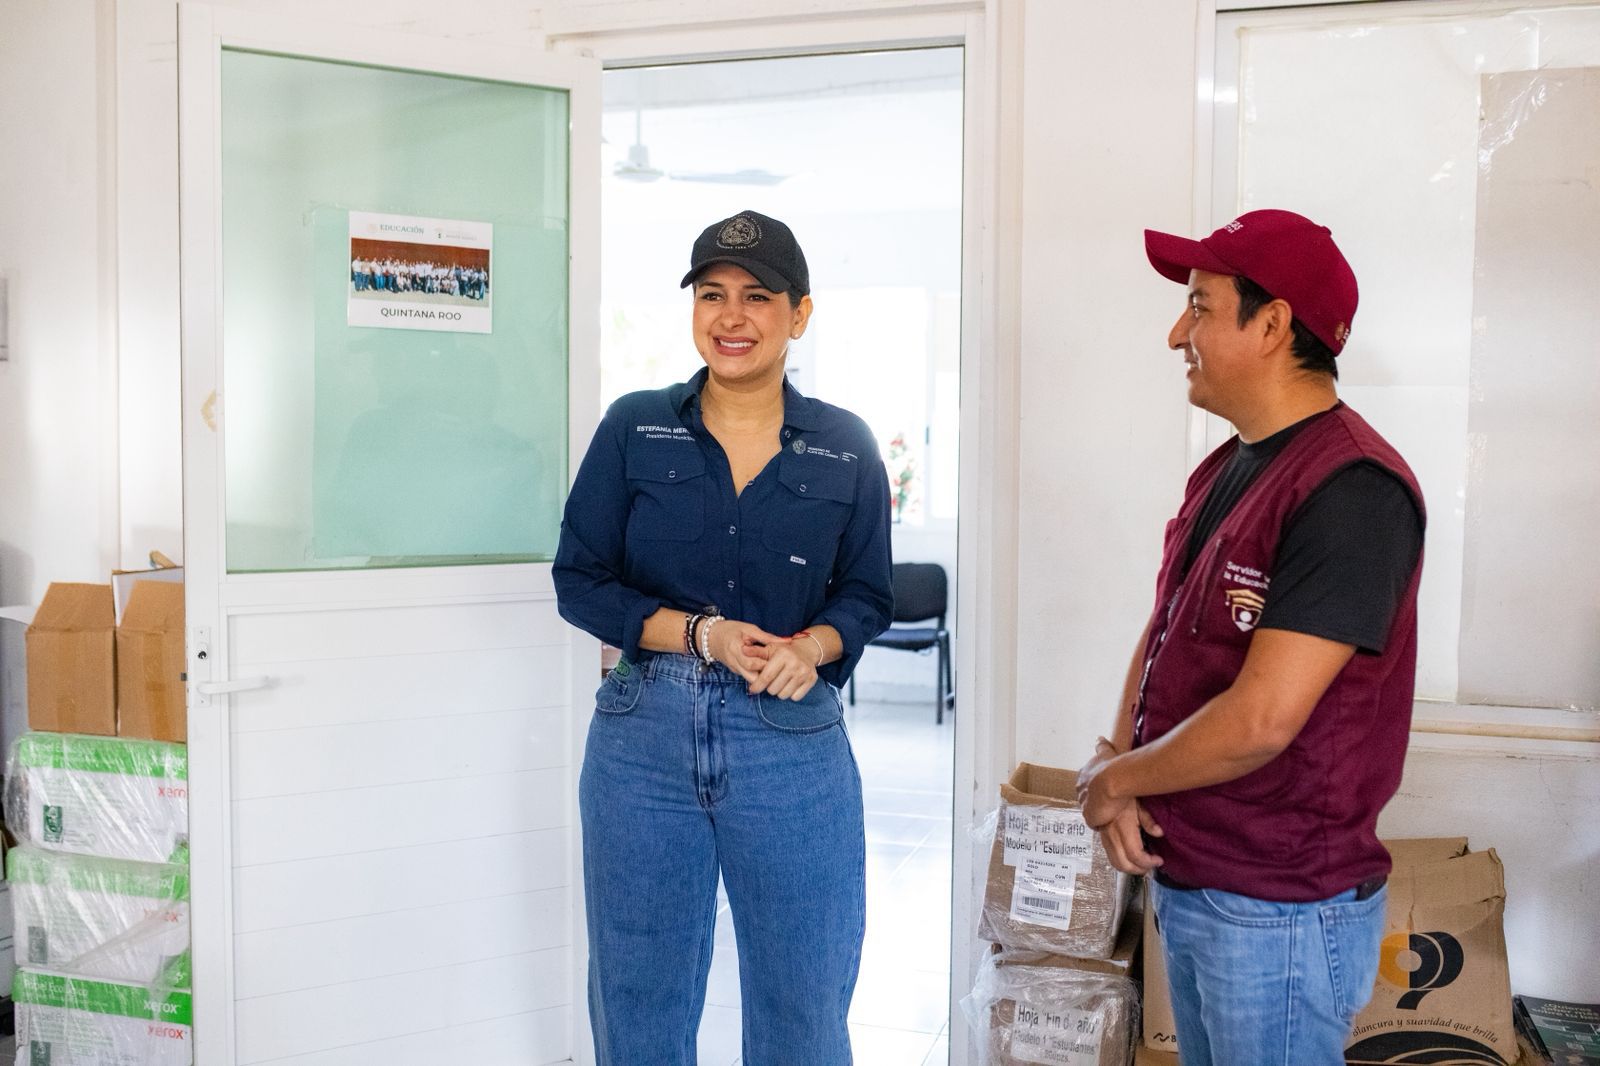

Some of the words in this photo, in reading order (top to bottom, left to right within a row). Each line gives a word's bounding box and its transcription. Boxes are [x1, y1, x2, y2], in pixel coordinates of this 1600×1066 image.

[379, 223, 425, 235] EDUCACIÓN
[380, 307, 436, 320] QUINTANA
[438, 311, 462, 321] ROO
[1008, 813, 1029, 834] Hoja
[1052, 818, 1065, 834] de
[1005, 836, 1032, 851] Modelo
[143, 999, 178, 1014] xerox
[1018, 1004, 1039, 1029] Hoja
[147, 1026, 184, 1040] xerox
[1397, 1018, 1403, 1028] y
[1405, 1017, 1453, 1027] suavidad
[1453, 1021, 1472, 1032] que
[1473, 1025, 1498, 1044] brilla
